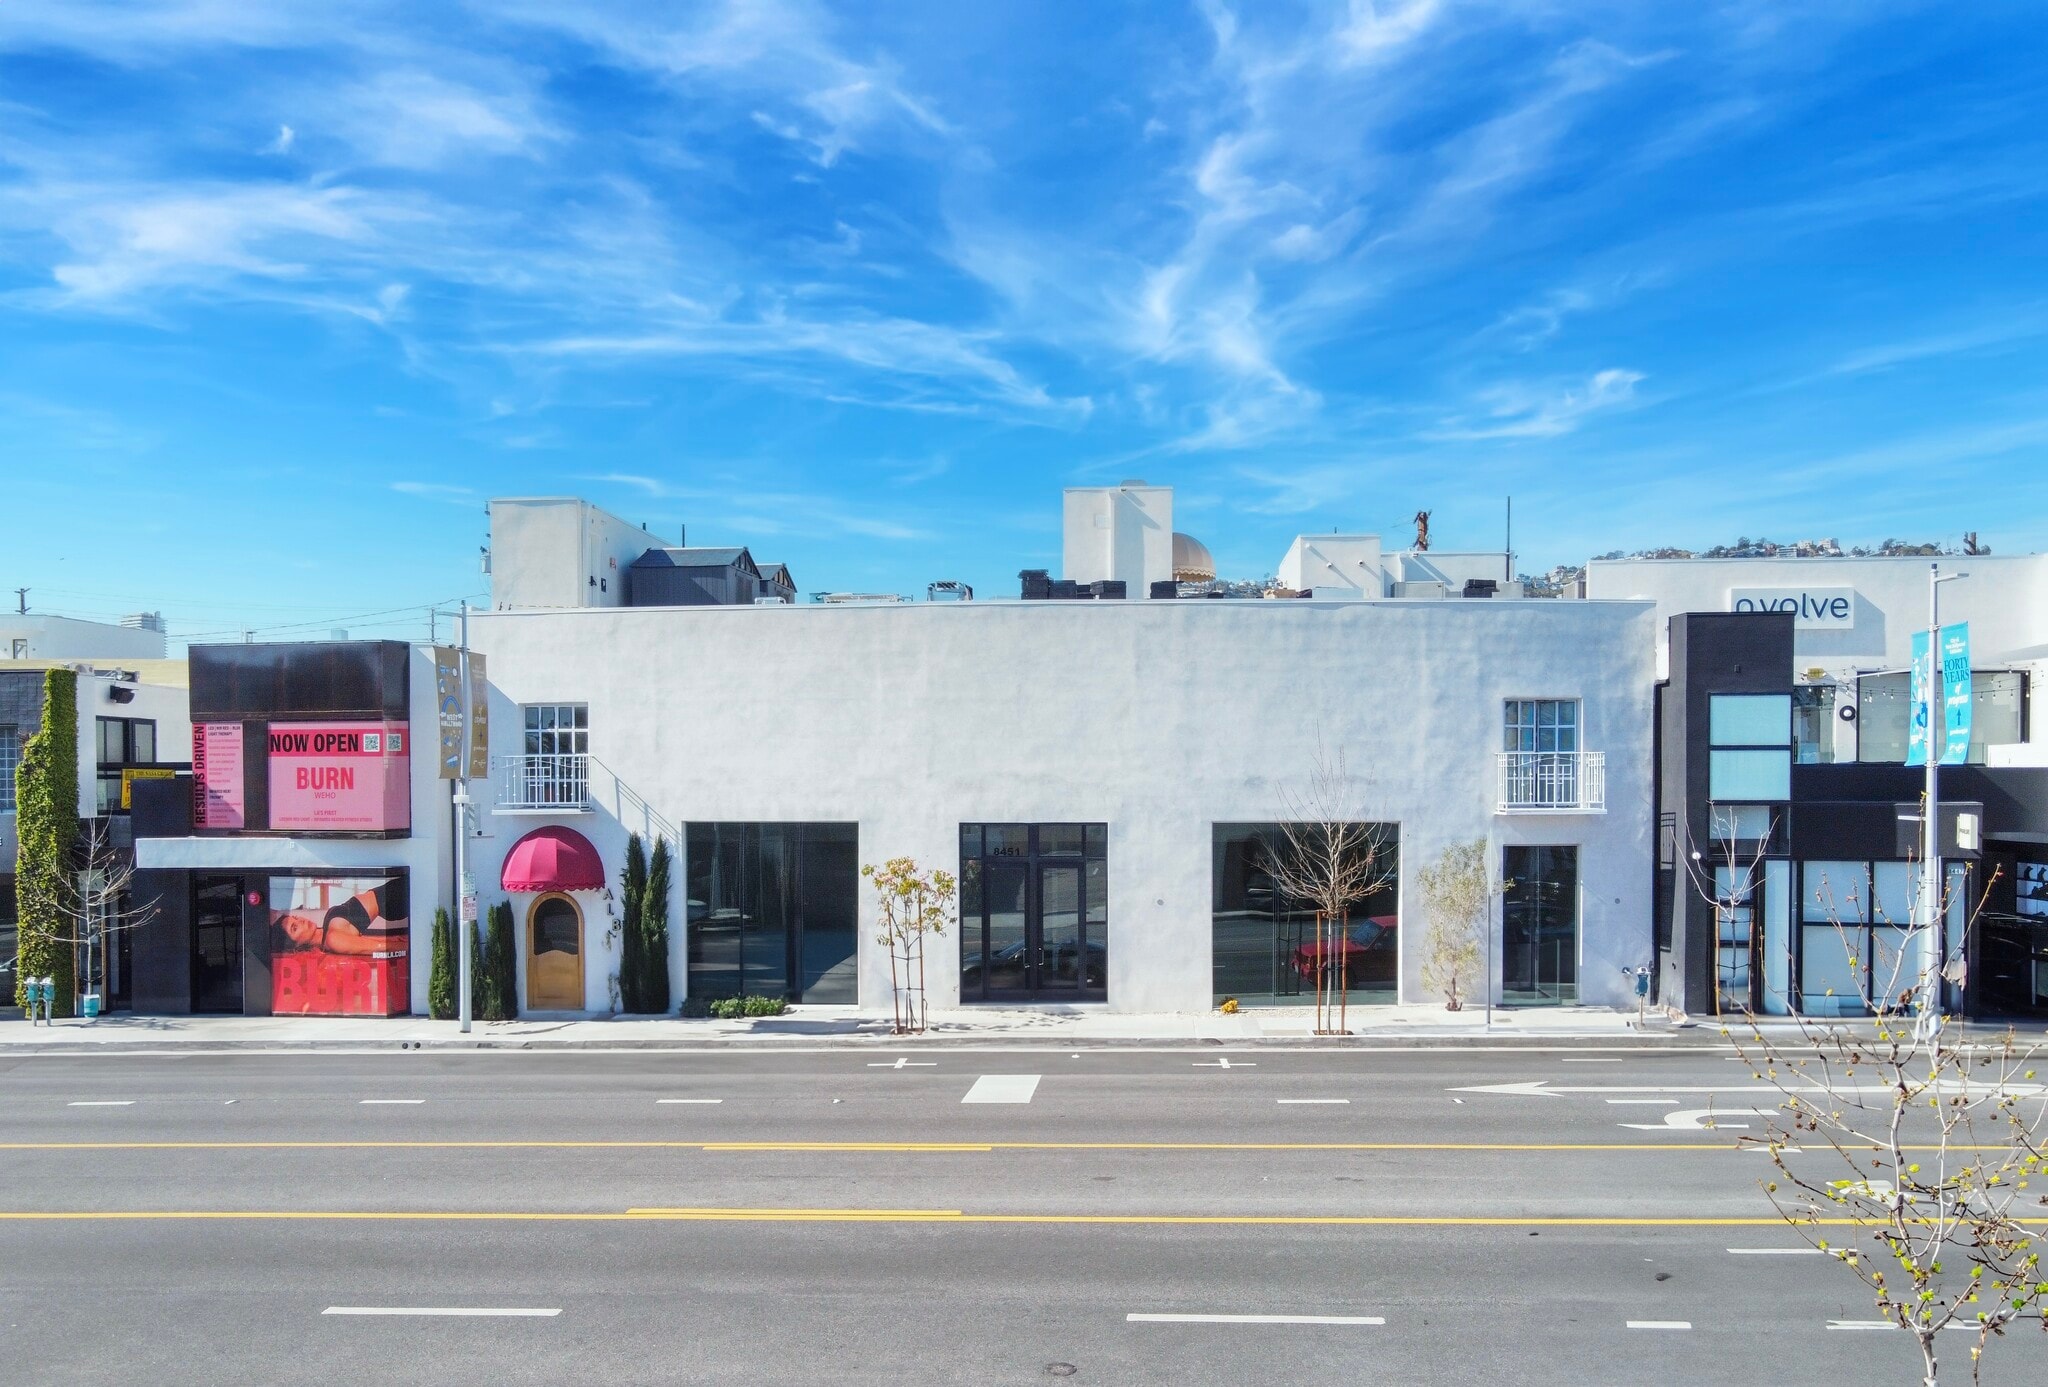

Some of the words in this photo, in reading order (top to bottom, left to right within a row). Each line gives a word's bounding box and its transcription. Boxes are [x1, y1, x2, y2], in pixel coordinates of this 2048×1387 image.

[1944, 657, 1968, 671] FORTY
[1945, 669, 1969, 683] YEARS
[194, 727, 204, 769] DRIVEN
[270, 734, 309, 752] NOW
[314, 734, 358, 752] OPEN
[297, 767, 353, 789] BURN
[195, 773, 205, 823] RESULTS
[279, 958, 406, 1013] BURN
